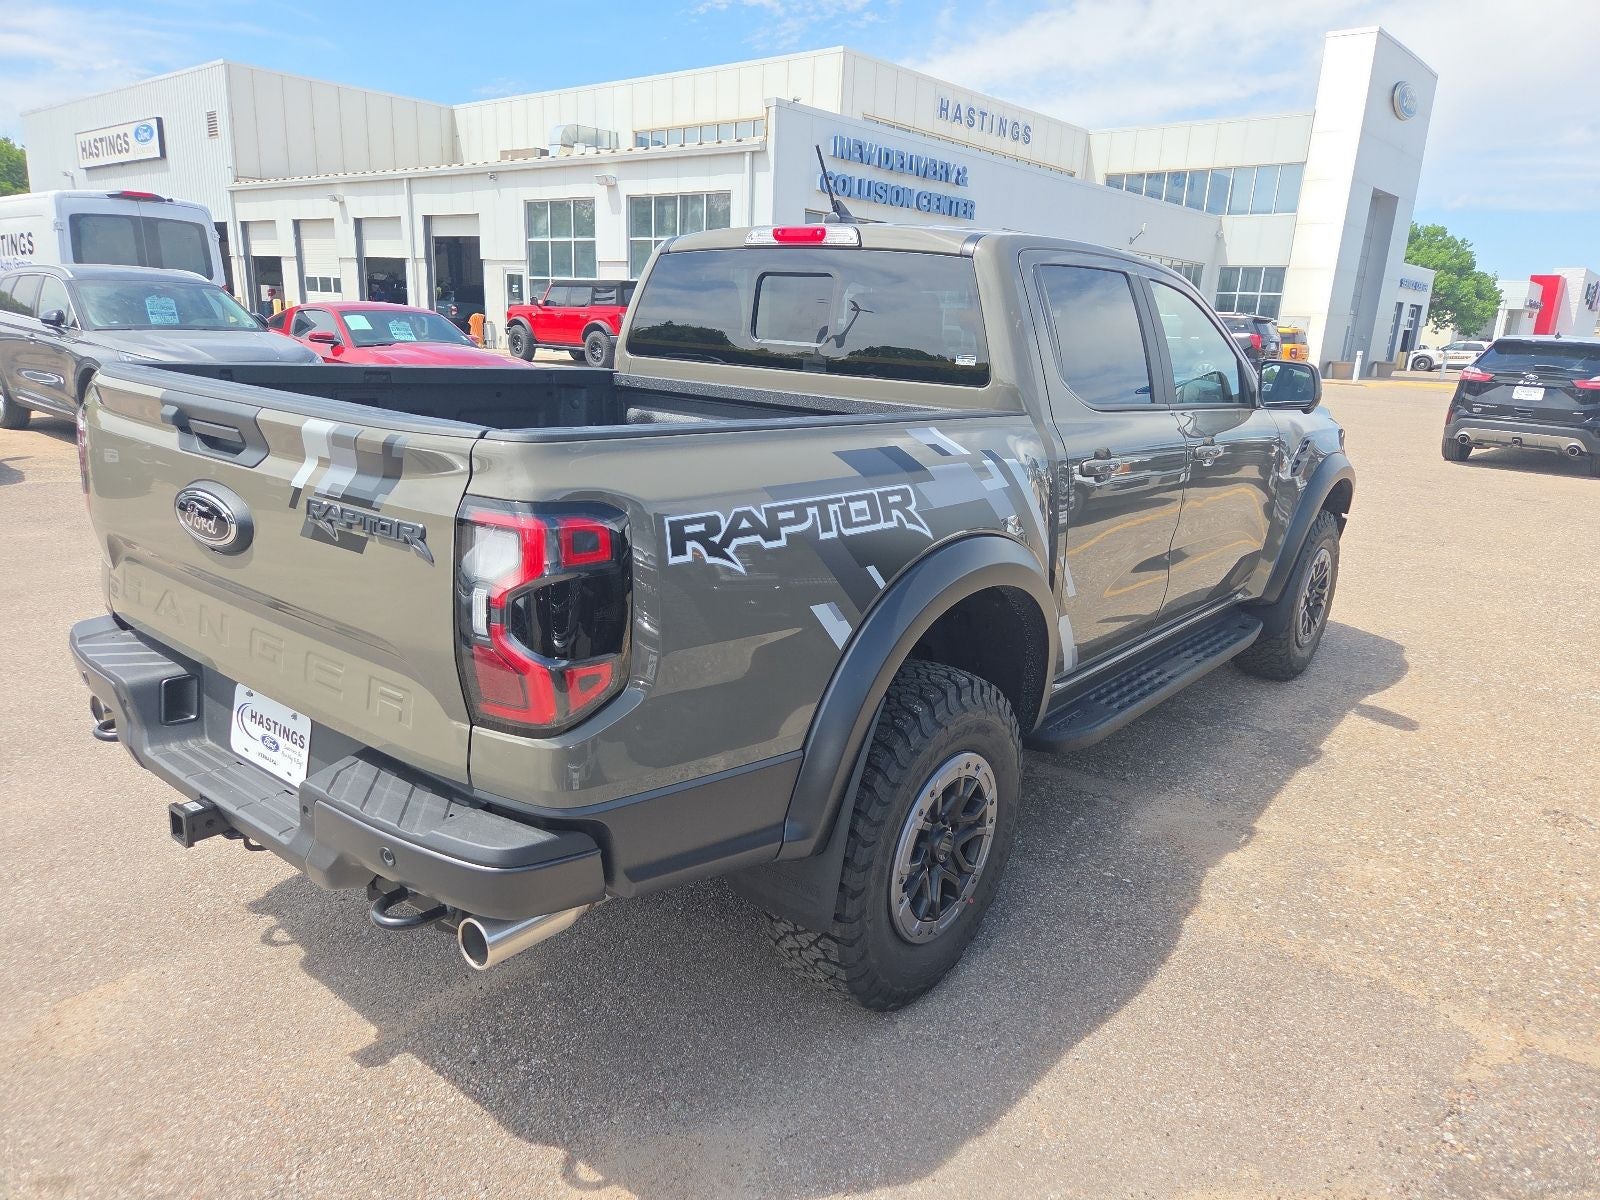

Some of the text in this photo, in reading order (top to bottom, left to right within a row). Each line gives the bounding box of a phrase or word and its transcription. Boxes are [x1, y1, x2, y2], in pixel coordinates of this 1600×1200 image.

[938, 97, 1032, 145] HASTINGS
[80, 132, 130, 160] HASTINGS
[831, 135, 969, 188] NEW DELIVERY &
[816, 170, 976, 221] COLLISION CENTER
[185, 500, 218, 535] Ford
[306, 496, 435, 567] RAPTOR
[664, 483, 934, 576] RAPTOR
[122, 566, 415, 730] RANGER
[250, 709, 306, 749] HASTINGS
[262, 736, 279, 751] Ford
